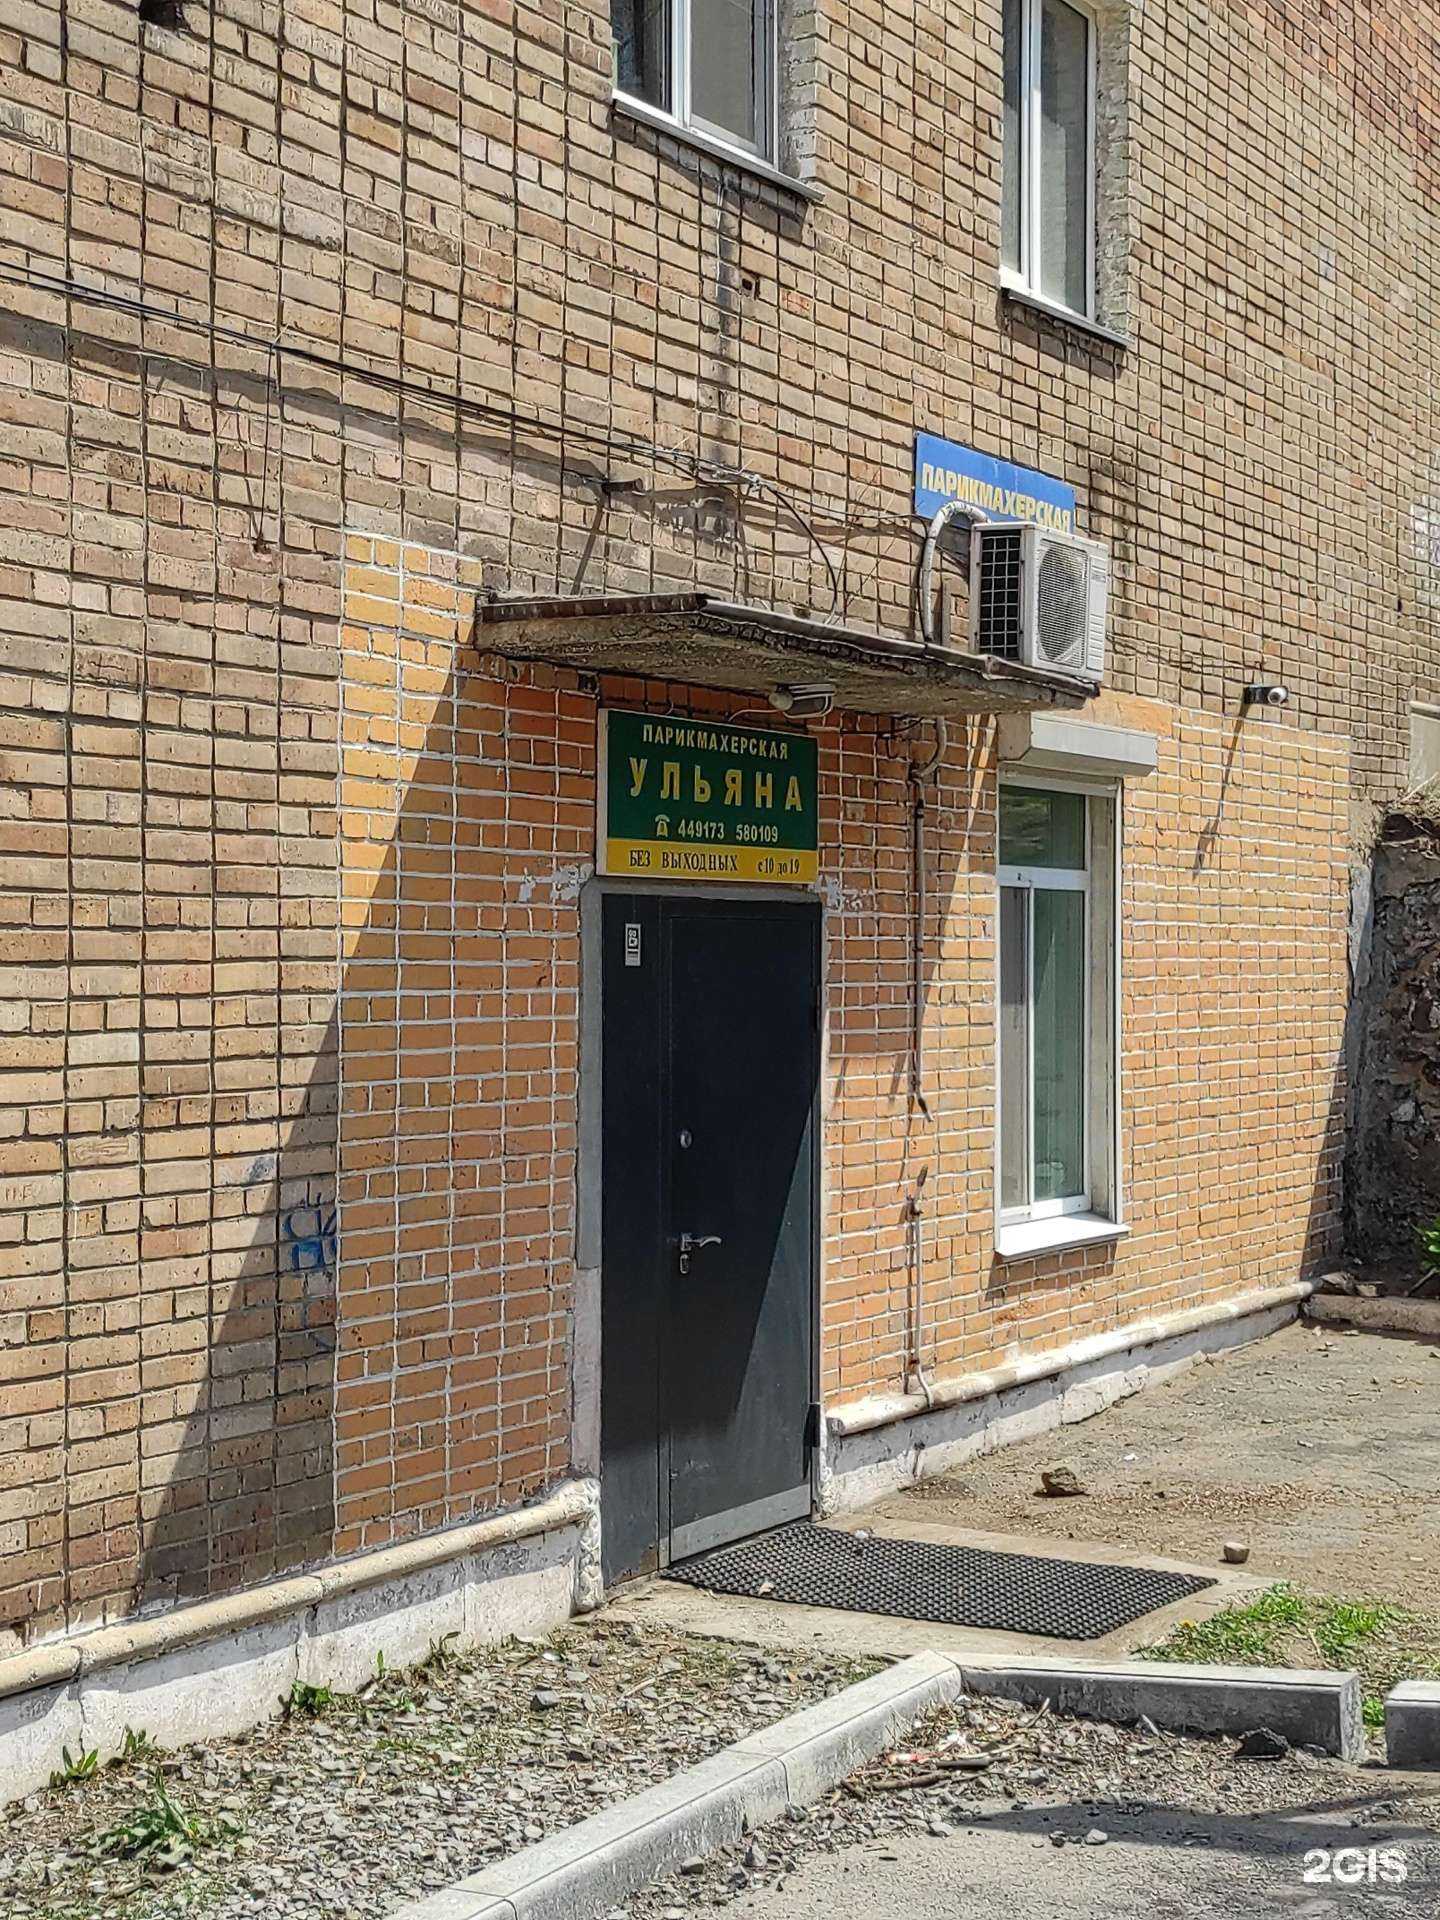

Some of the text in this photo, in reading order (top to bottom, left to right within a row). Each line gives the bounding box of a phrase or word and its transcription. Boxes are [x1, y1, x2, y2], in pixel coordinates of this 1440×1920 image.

[921, 462, 1071, 532] ПАРИКМАХЕРСКАЯ
[643, 724, 788, 760] ПАРИКМАХЕРСКАЯ
[629, 756, 803, 812] УЛЬЯНА
[677, 818, 779, 843] 449173 580109
[629, 849, 651, 868] БЕЗ
[661, 851, 738, 873] ВЫХОДНЫХ
